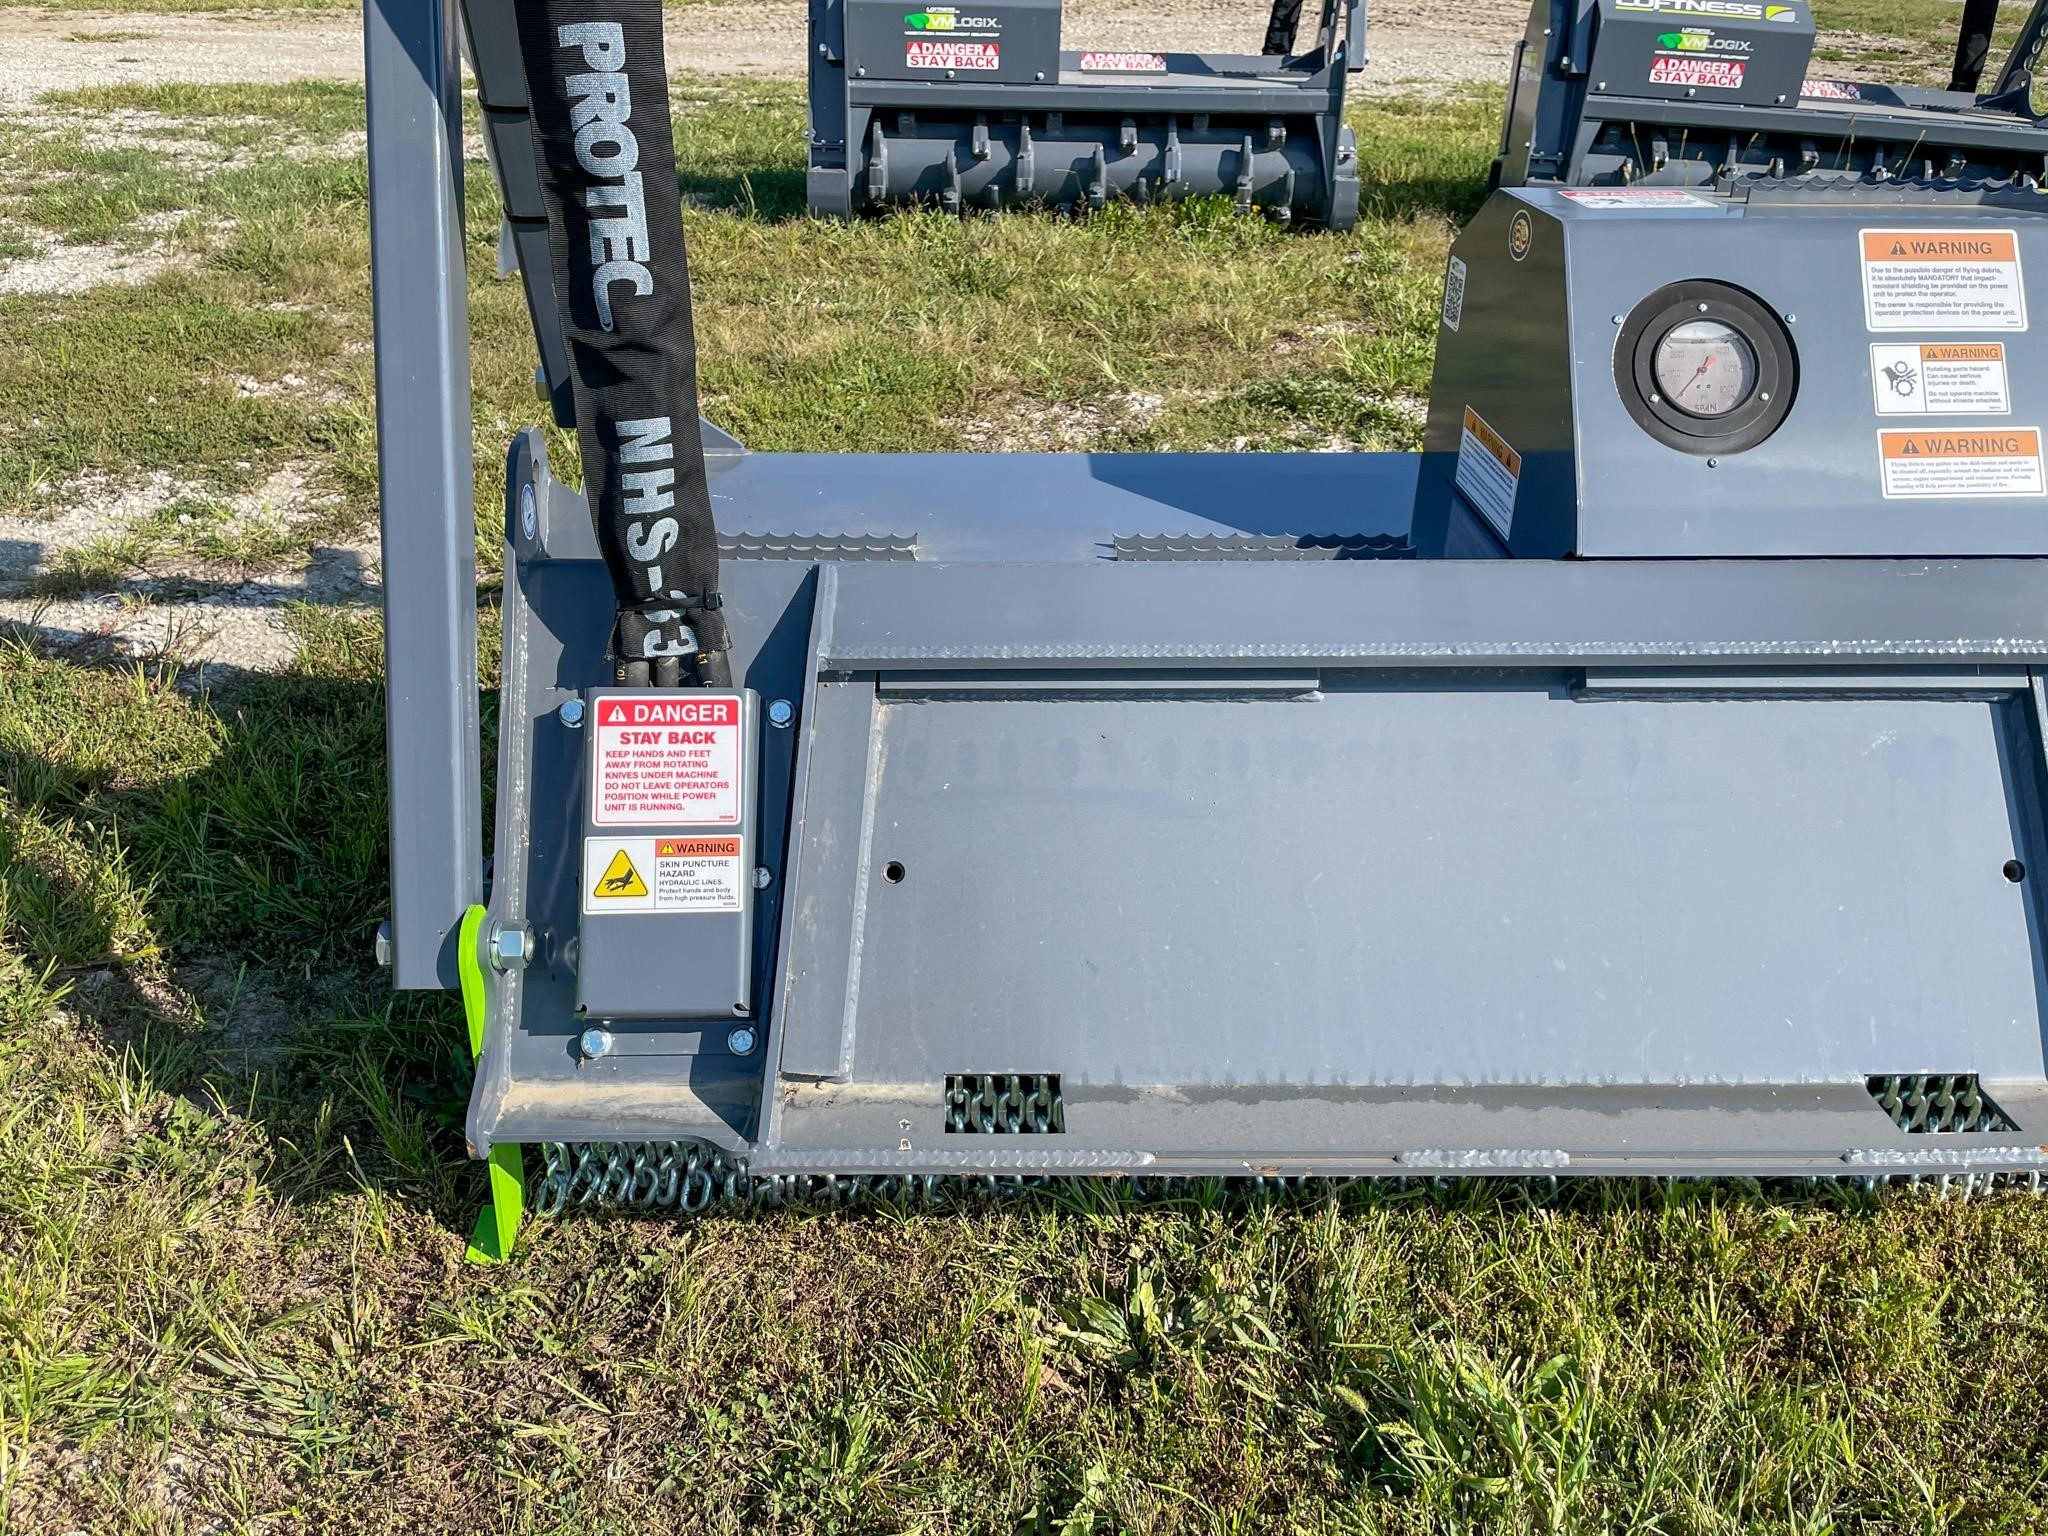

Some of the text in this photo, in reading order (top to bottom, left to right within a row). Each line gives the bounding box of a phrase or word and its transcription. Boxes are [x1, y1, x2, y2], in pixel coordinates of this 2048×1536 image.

[922, 43, 984, 55] DANGER
[910, 56, 995, 67] STAY BACK
[1096, 53, 1153, 61] DANGER
[1085, 61, 1163, 69] STAY BACK
[1668, 59, 1730, 74] DANGER
[1653, 72, 1738, 86] STAY BACK
[1803, 80, 1845, 90] ANGER
[1820, 89, 1857, 99] BACK
[1911, 242, 1992, 254] WARNING
[1940, 348, 1998, 358] WARNING
[1925, 438, 2019, 453] WARNING
[634, 705, 727, 722] DANGER
[619, 731, 716, 744] STAY BACK
[677, 843, 735, 853] WARNING
[682, 859, 729, 867] PUNCTURE
